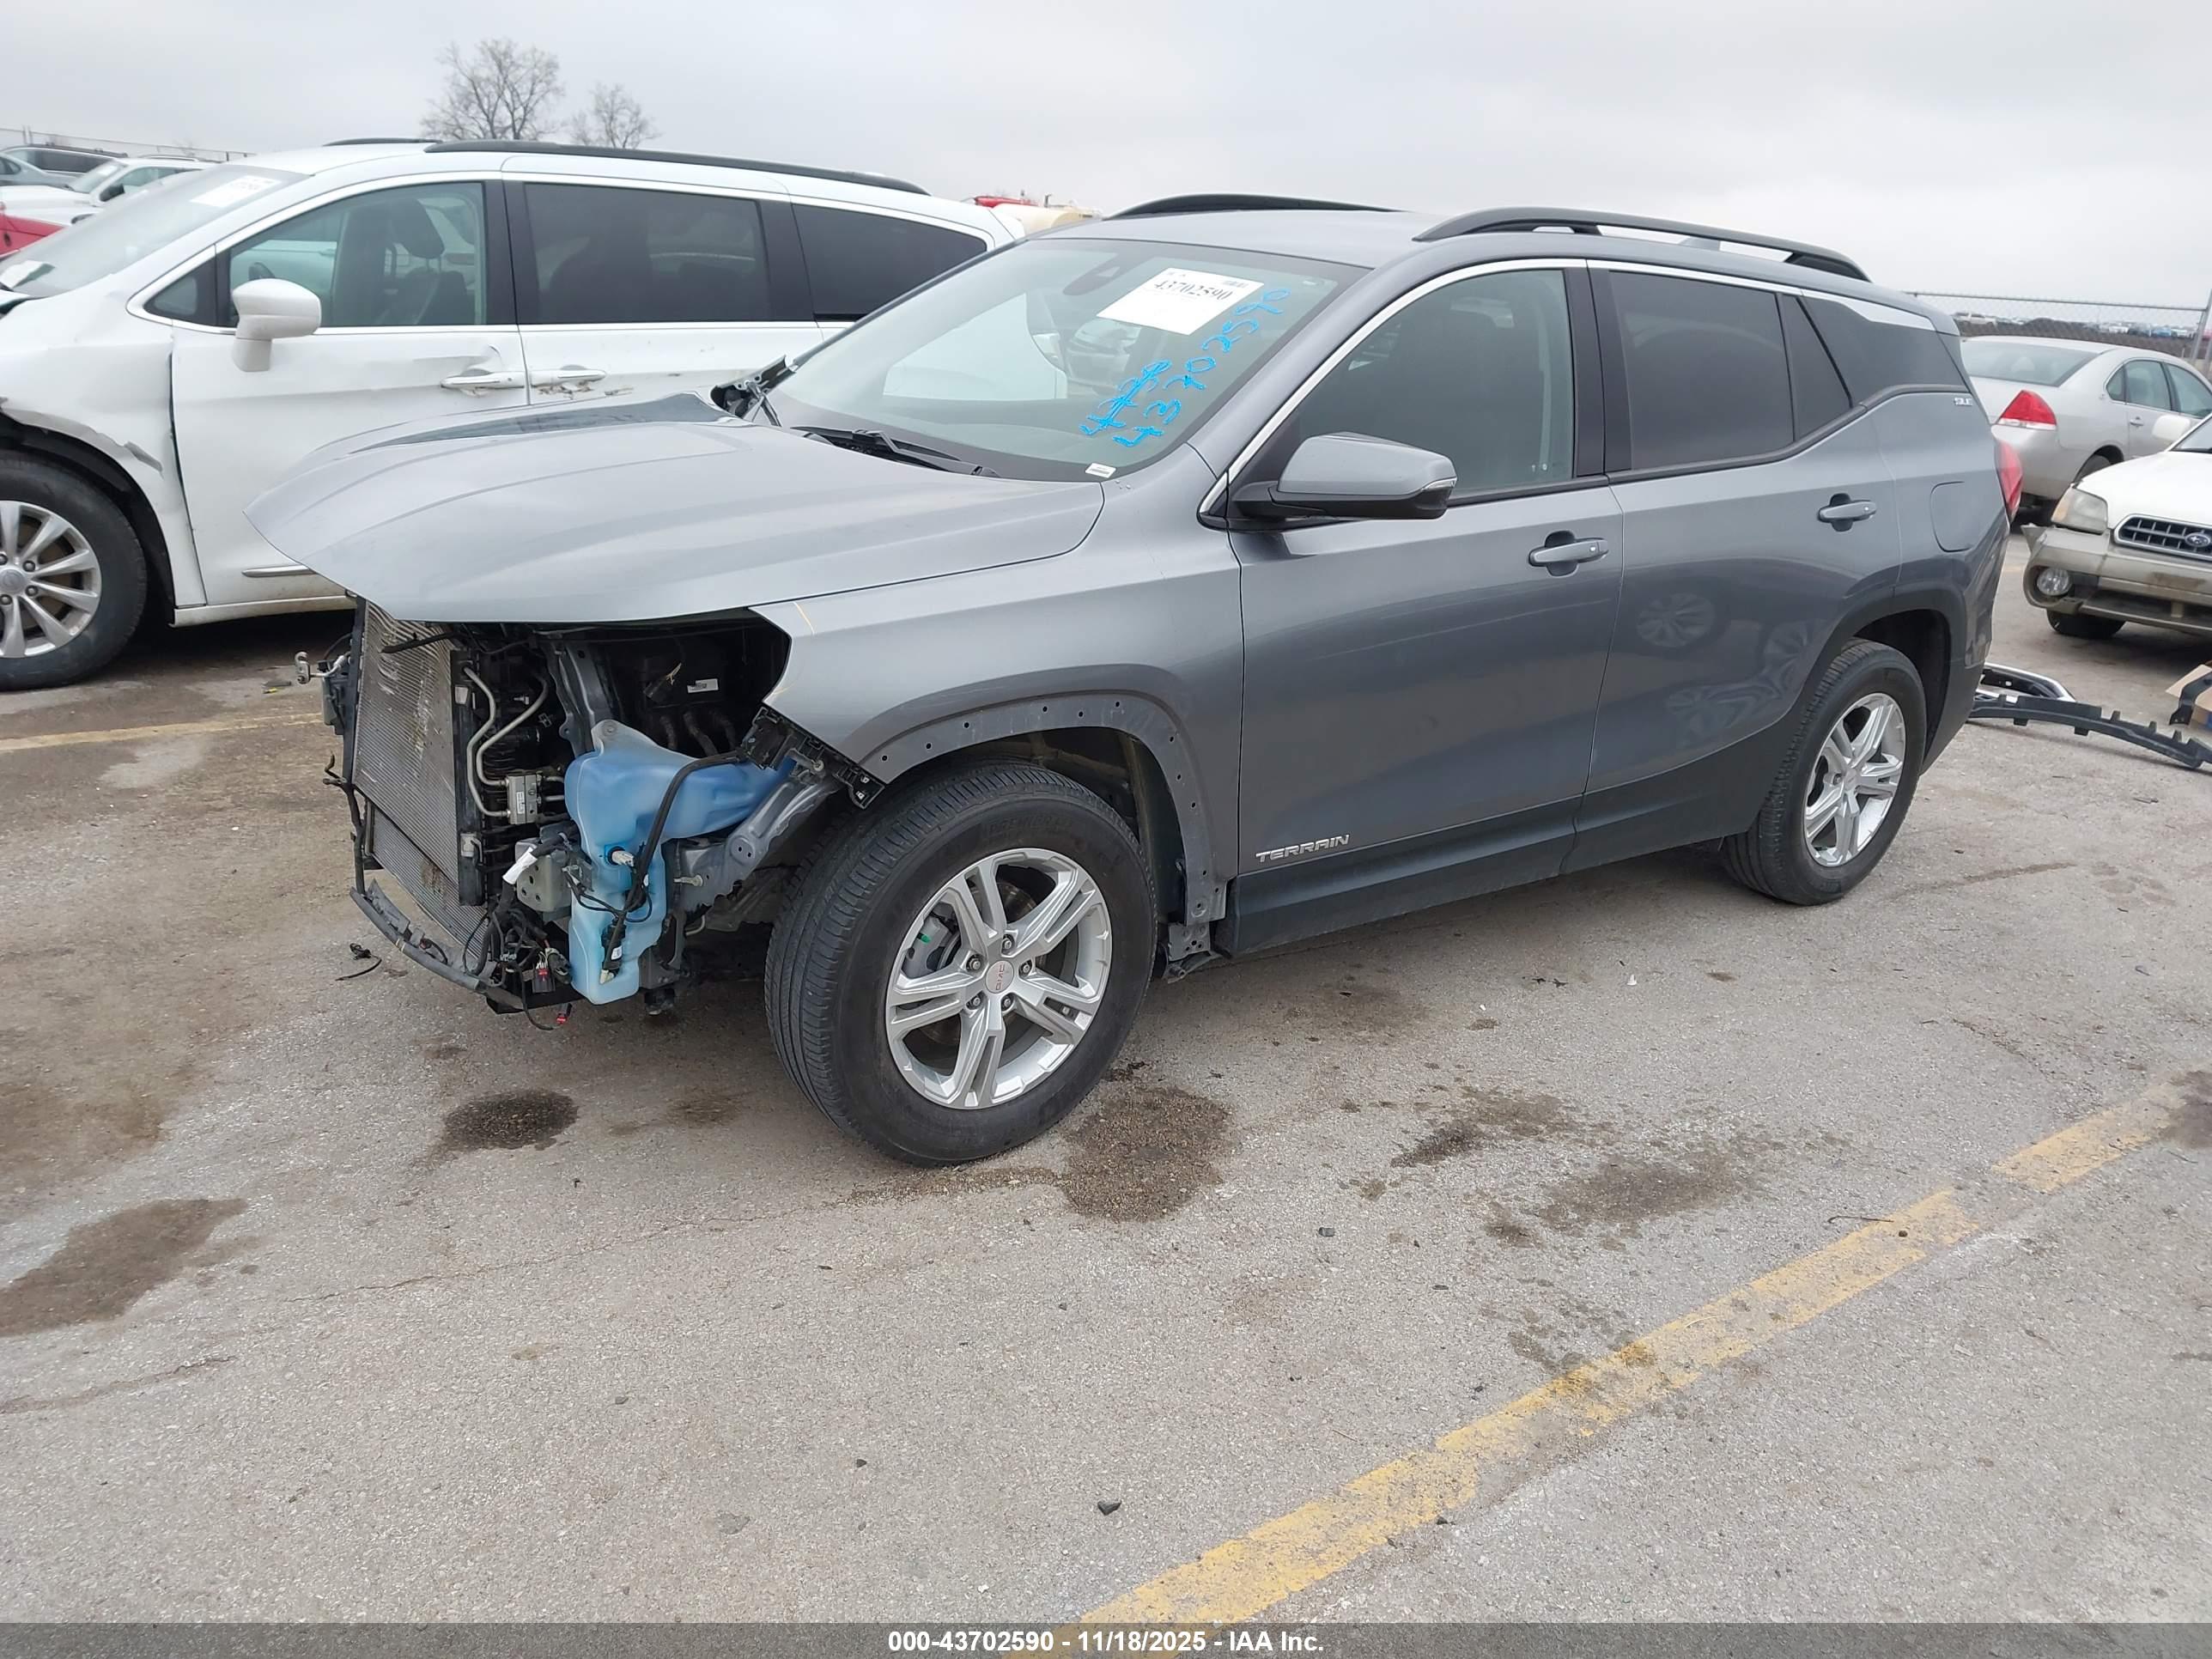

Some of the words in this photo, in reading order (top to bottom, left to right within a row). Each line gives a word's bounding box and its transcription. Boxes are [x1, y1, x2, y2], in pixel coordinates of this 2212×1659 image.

[1112, 287, 1292, 447] 43702590
[1255, 834, 1350, 863] TERRAIN
[995, 963, 1006, 991] GMC
